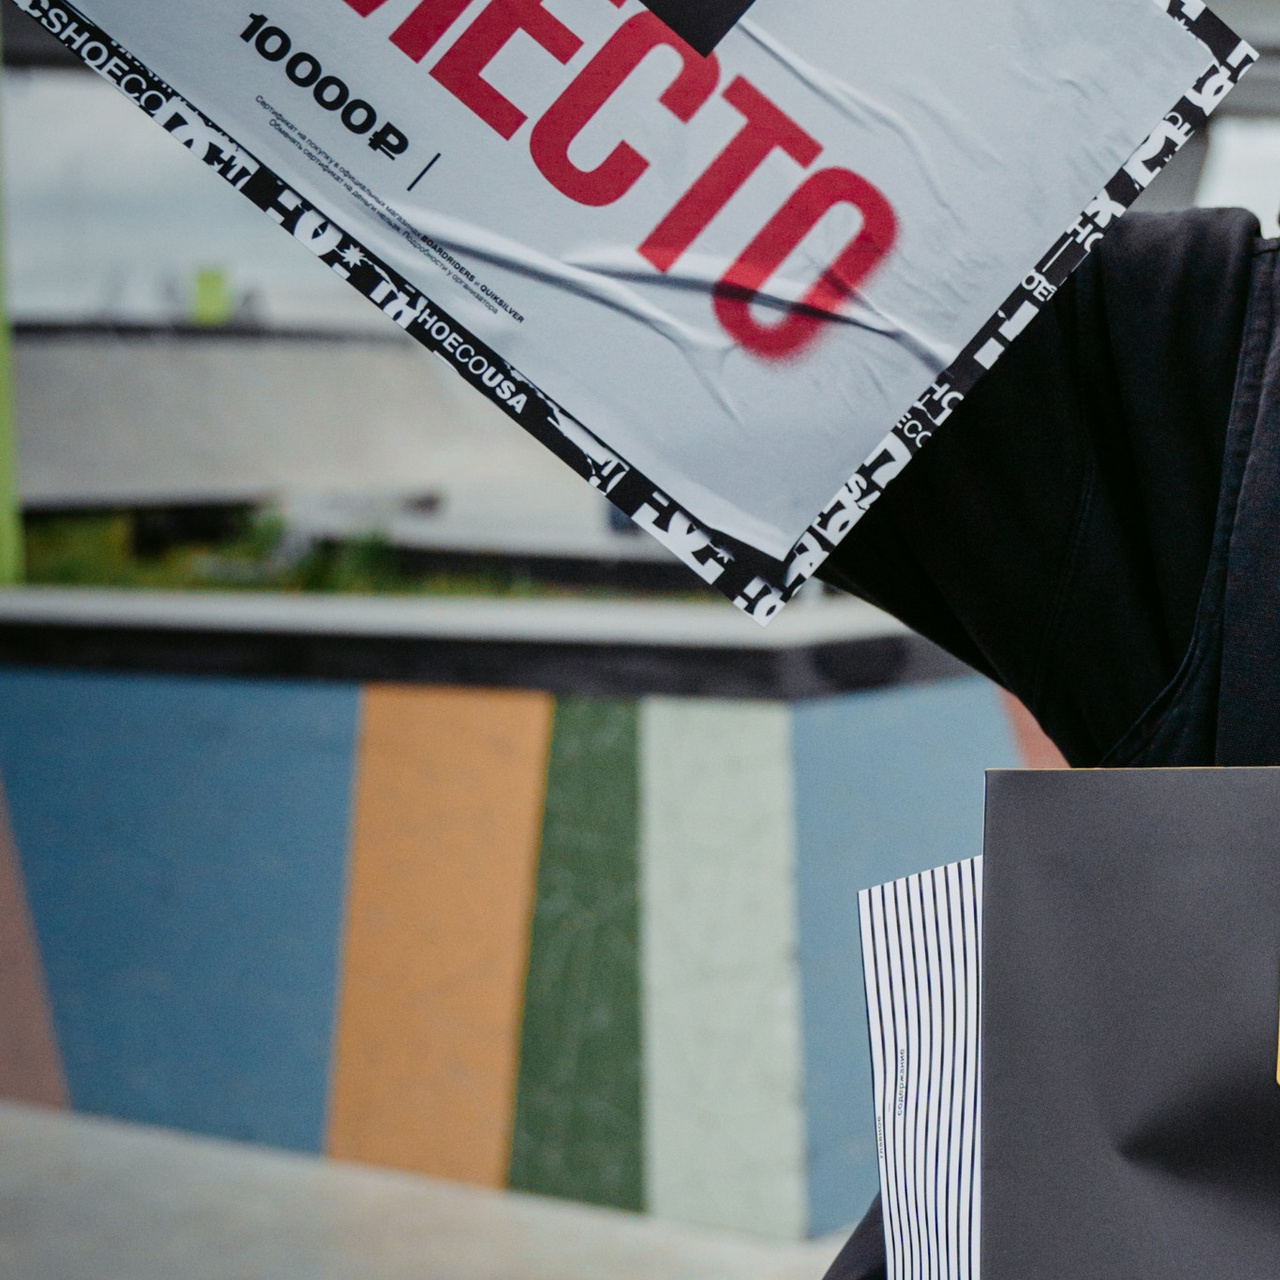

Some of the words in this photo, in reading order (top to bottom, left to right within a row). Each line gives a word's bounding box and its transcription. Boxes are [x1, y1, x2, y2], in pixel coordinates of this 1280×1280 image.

[254, 95, 298, 132] Сертификат
[296, 130, 307, 140] на
[305, 139, 333, 163] покупку
[338, 166, 385, 207] официальных
[421, 235, 475, 281] BOARDRIDERS
[480, 284, 524, 322] QUIKSILVER
[269, 119, 304, 149] Обменять
[302, 148, 343, 184] сертификат
[342, 182, 353, 192] на
[352, 190, 376, 212] деньги
[401, 231, 448, 271] Подробности
[452, 274, 498, 313] организатора
[897, 1048, 906, 1117] содержание
